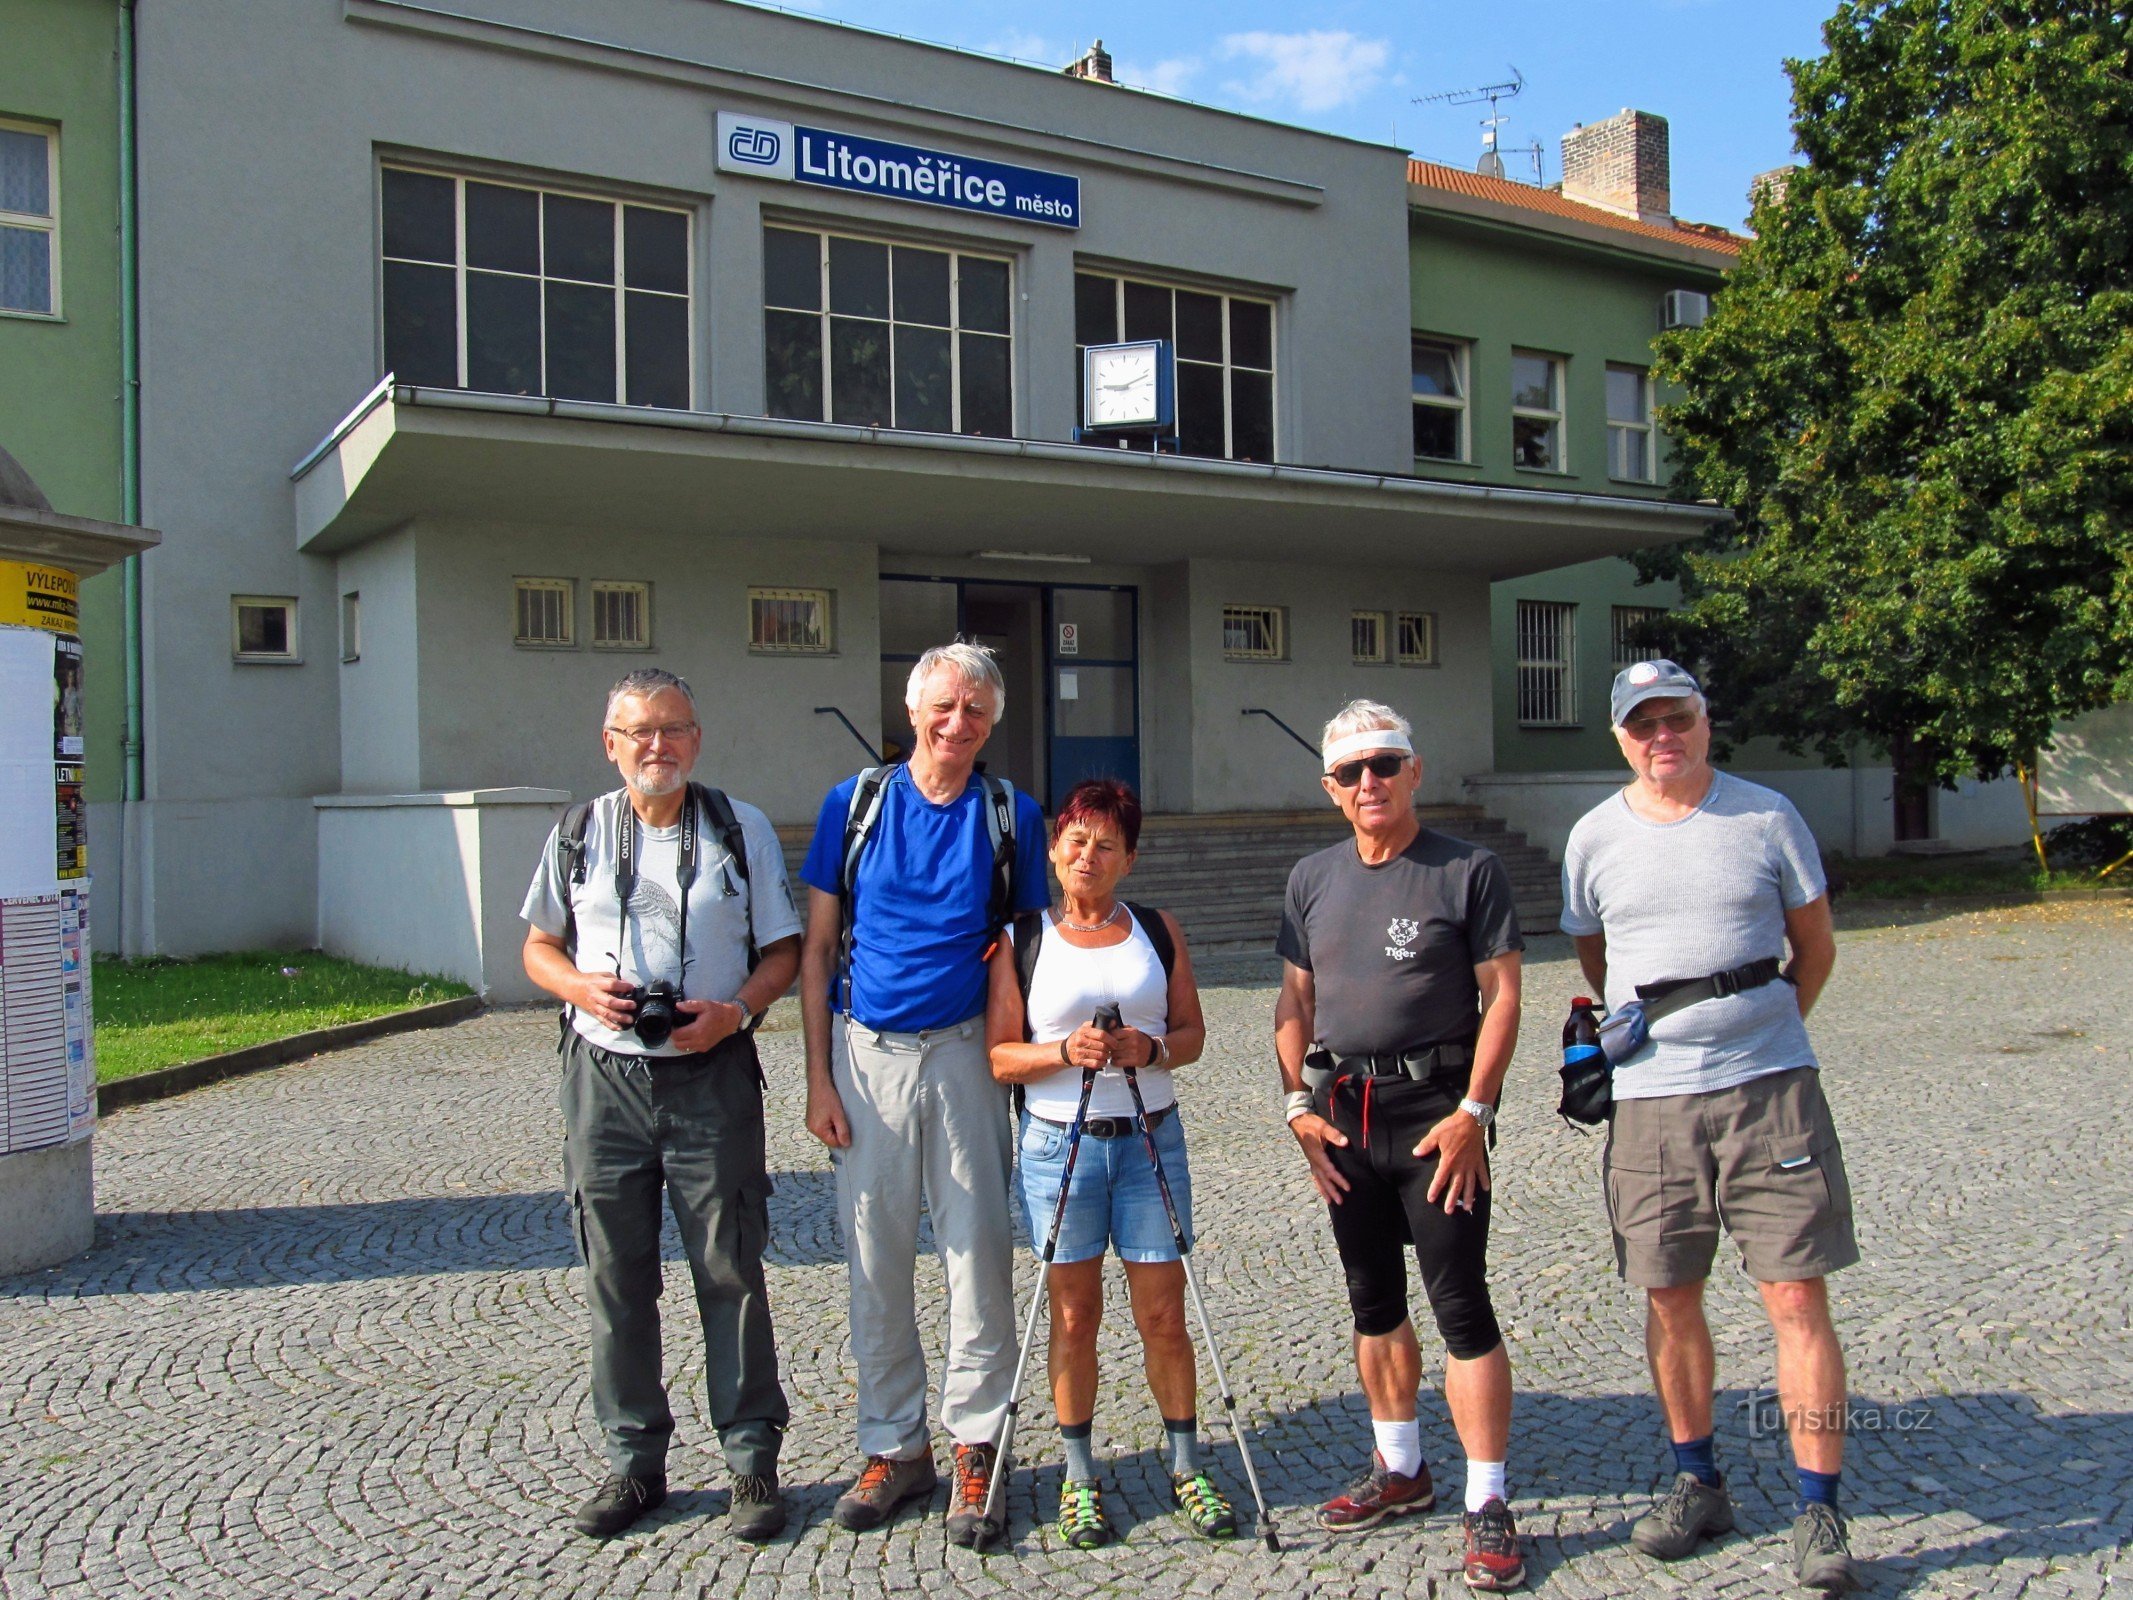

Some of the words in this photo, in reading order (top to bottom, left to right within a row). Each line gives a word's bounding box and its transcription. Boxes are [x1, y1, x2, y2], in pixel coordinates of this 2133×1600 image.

[802, 136, 1006, 207] Litoměřice
[1015, 194, 1073, 219] město
[621, 814, 630, 859] OLYMPUS
[683, 806, 693, 851] OLYMPUS
[1384, 946, 1416, 960] Tiger
